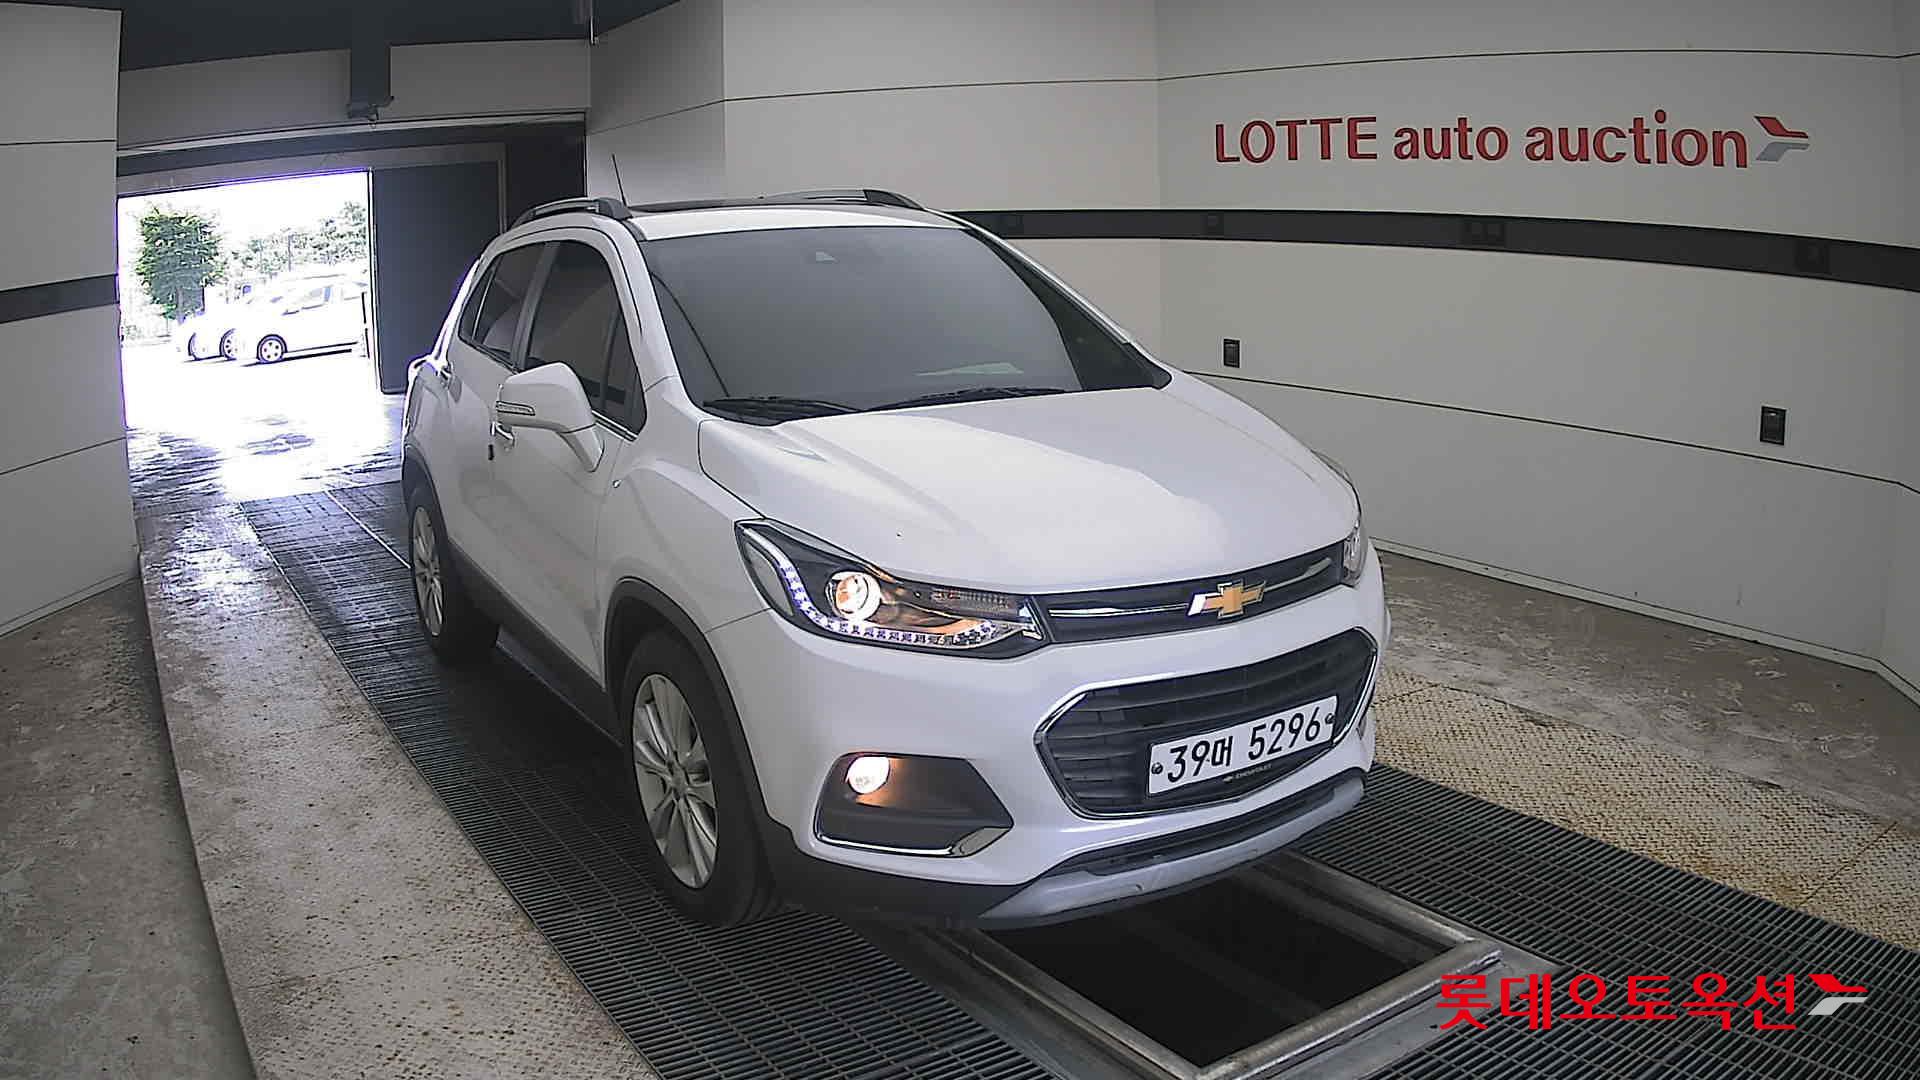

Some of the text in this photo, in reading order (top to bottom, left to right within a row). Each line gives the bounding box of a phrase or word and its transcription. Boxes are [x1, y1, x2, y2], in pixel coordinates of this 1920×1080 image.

[1215, 110, 1749, 168] LOTTE auto auction
[1167, 706, 1321, 782] 39머 5296
